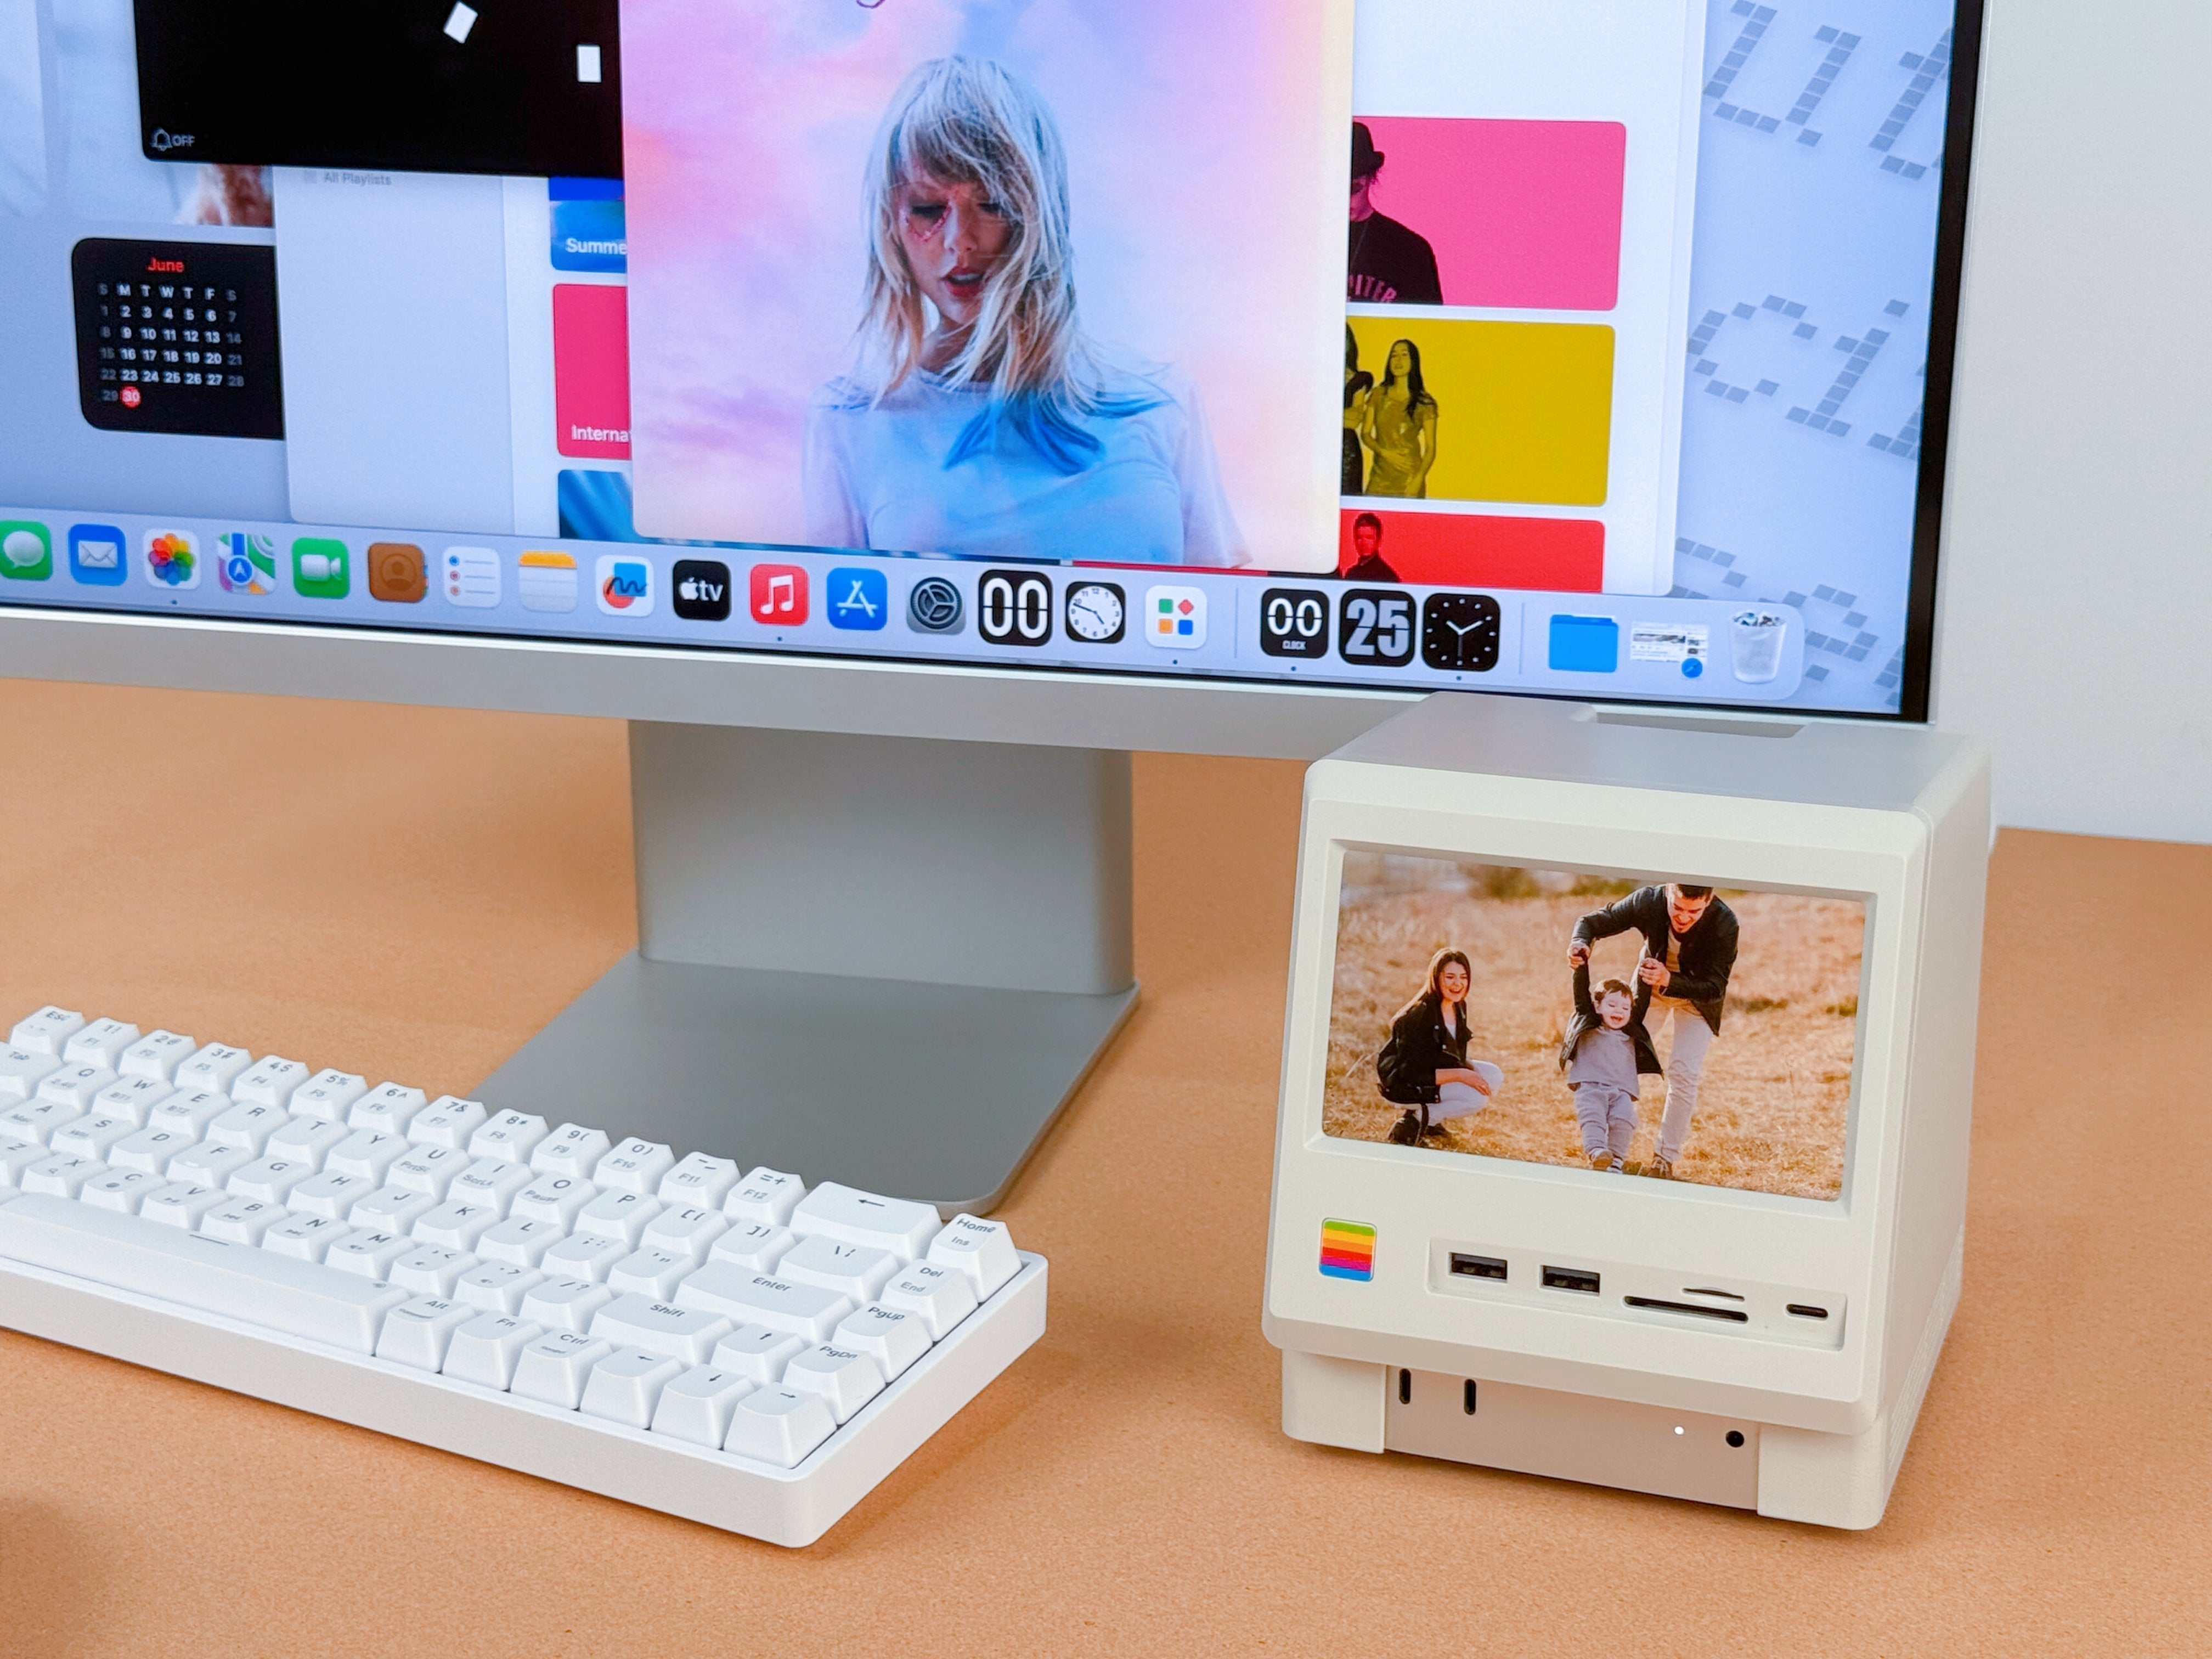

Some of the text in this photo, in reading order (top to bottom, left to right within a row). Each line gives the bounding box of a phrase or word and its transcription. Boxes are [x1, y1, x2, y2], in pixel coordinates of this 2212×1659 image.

[172, 134, 195, 147] OFF
[325, 172, 392, 187] All Playlists
[147, 257, 185, 273] June
[116, 283, 131, 297] M
[140, 285, 151, 297] T
[159, 285, 174, 298] W
[183, 287, 194, 300] T
[205, 287, 215, 300] F
[120, 305, 131, 318] 2
[142, 306, 153, 319] 3
[163, 307, 173, 319] 4
[183, 308, 194, 321] 5
[205, 309, 217, 322] 6
[121, 327, 132, 339] 9
[140, 328, 156, 340] 10
[163, 329, 177, 341] 11
[183, 329, 199, 342] 12
[205, 331, 221, 343] 13
[120, 347, 136, 360] 16
[142, 348, 157, 361] 17
[163, 349, 179, 363] 18
[184, 351, 200, 364] 19
[205, 352, 222, 365] 20
[120, 369, 138, 381] 23
[142, 370, 159, 383] 24
[165, 371, 180, 383] 25
[185, 372, 202, 385] 26
[206, 374, 223, 386] 27
[124, 390, 138, 402] 30
[699, 581, 724, 602] tv
[983, 577, 1048, 639] 00
[1267, 597, 1323, 637] 00
[1345, 598, 1410, 657] 25
[1282, 639, 1307, 651] CLOCK
[46, 1011, 71, 1021] Esc
[9, 1051, 30, 1060] Tab
[78, 1068, 96, 1077] Q
[133, 1080, 156, 1090] W
[190, 1093, 210, 1103] E
[35, 1105, 53, 1113] A
[247, 1107, 267, 1117] R
[95, 1119, 113, 1128] S
[310, 1121, 328, 1131] T
[151, 1133, 171, 1142] D
[369, 1134, 387, 1146] Y
[489, 1131, 507, 1139] F8
[7, 1143, 28, 1151] Z
[210, 1146, 230, 1154] F
[552, 1144, 571, 1154] F9
[427, 1148, 448, 1160] U
[64, 1158, 87, 1167] X
[269, 1162, 289, 1172] G
[612, 1159, 637, 1169] F10
[125, 1173, 143, 1182] C
[331, 1176, 352, 1186] H
[552, 1179, 572, 1189] O
[393, 1193, 411, 1201] J
[524, 1189, 560, 1203] Pause
[617, 1194, 637, 1204] P
[743, 1188, 769, 1200] F12
[244, 1203, 264, 1211] B
[455, 1206, 476, 1216] K
[305, 1218, 329, 1228] N
[520, 1222, 534, 1232] L
[956, 1217, 997, 1233] Home
[368, 1233, 393, 1244] M
[951, 1236, 971, 1246] Ins
[919, 1266, 946, 1279] Del
[752, 1276, 793, 1293] Enter
[899, 1281, 928, 1294] End
[425, 1300, 450, 1310] Alt
[650, 1304, 686, 1318] Shift
[867, 1306, 906, 1322] PgUp
[495, 1317, 517, 1328] Fn
[559, 1334, 590, 1346] Ctrl
[819, 1345, 859, 1360] PgDn
